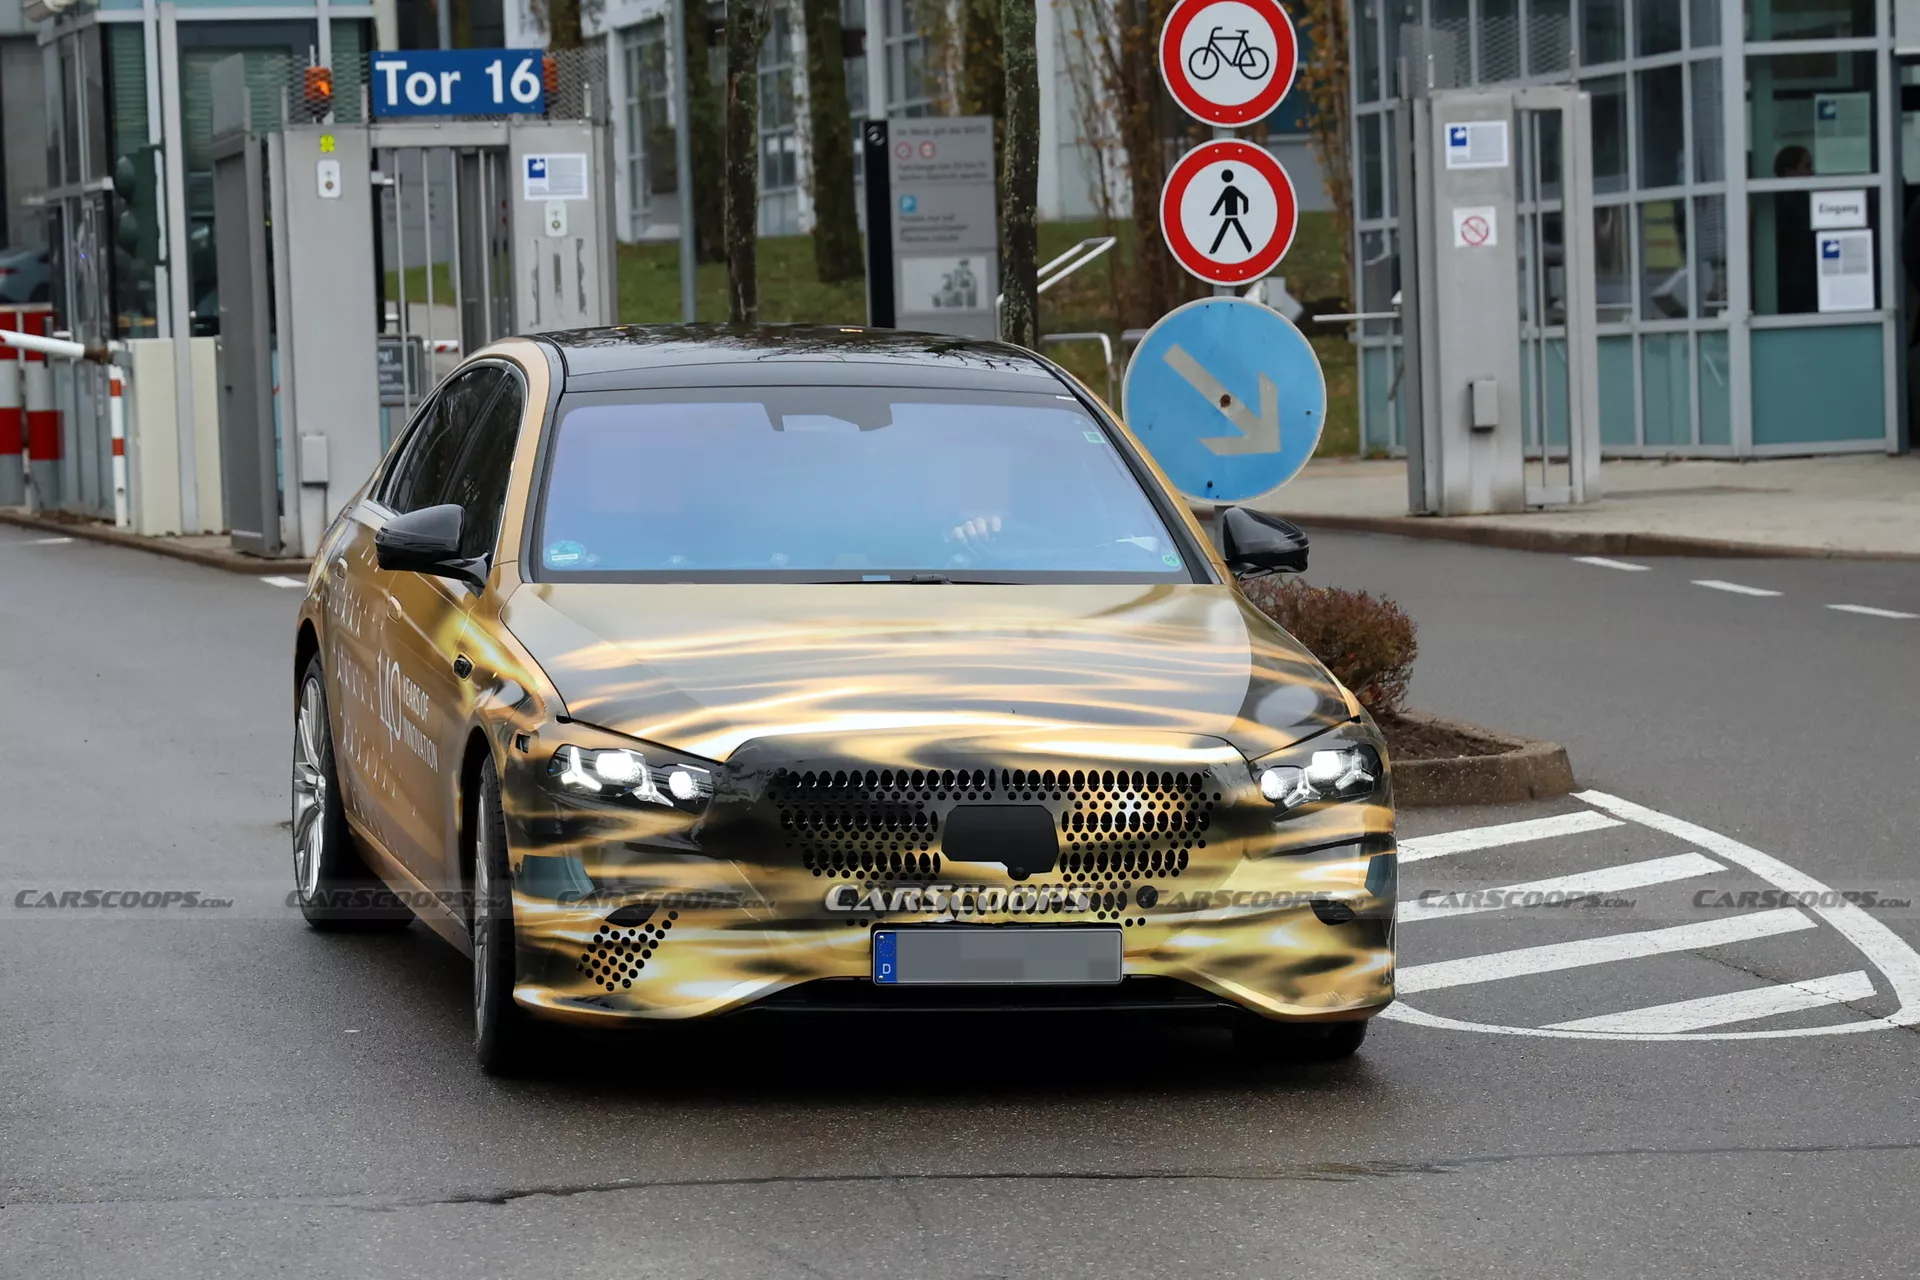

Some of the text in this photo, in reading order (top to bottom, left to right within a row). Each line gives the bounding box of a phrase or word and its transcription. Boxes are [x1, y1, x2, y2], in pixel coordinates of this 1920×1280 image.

[375, 58, 541, 106] Tor 16
[377, 649, 430, 753] 140 YEARS OF
[402, 715, 439, 773] INNOVATION
[882, 963, 892, 975] D
